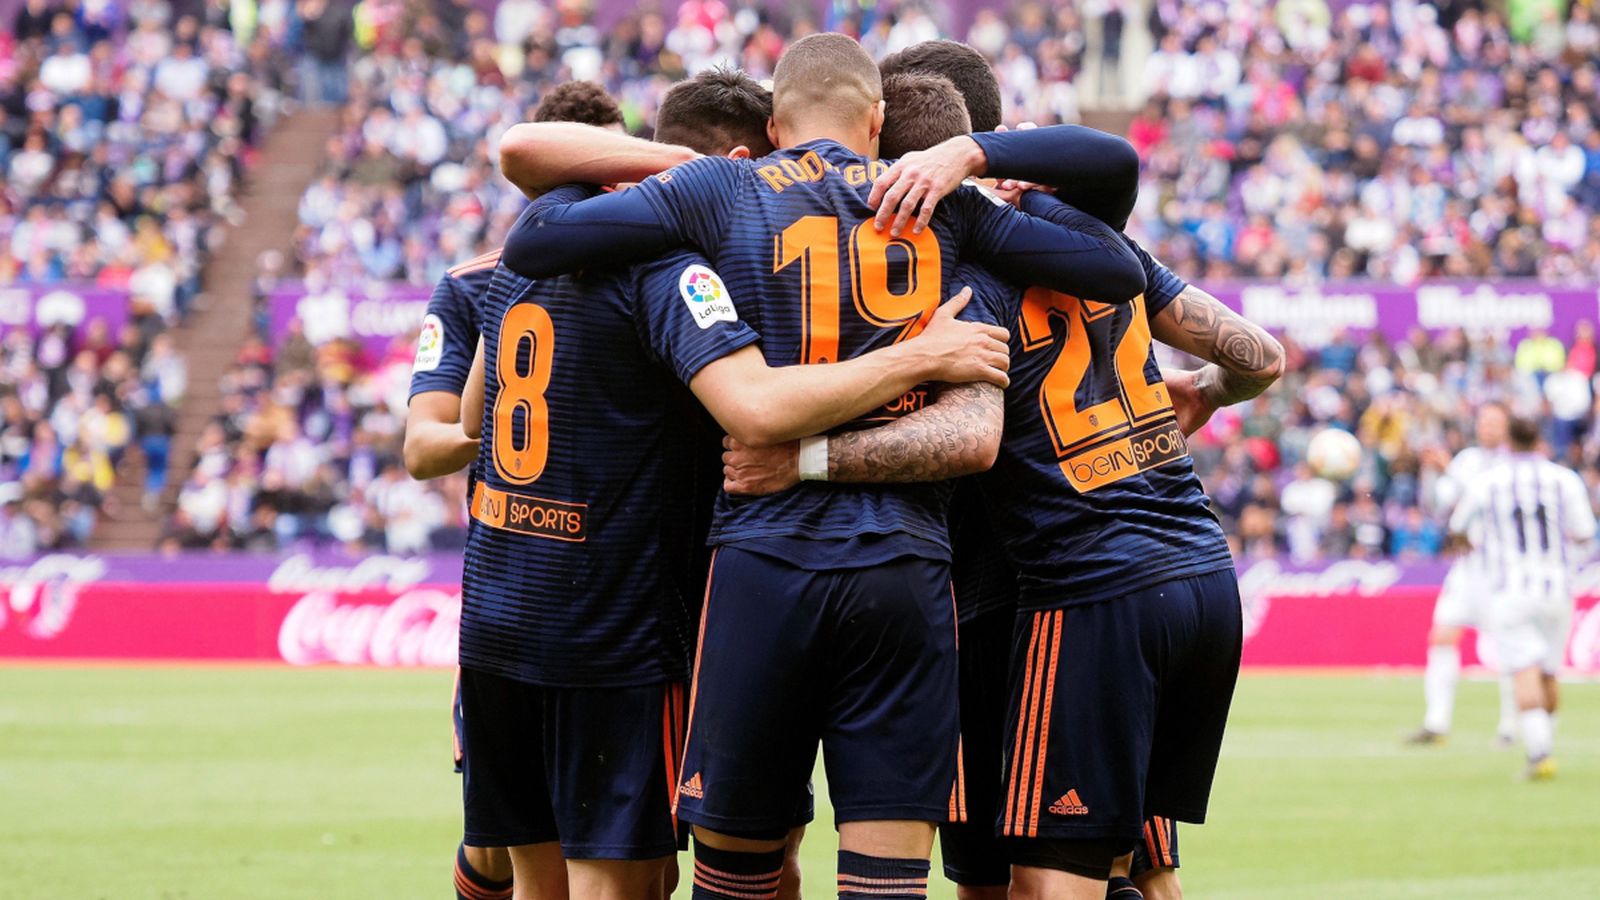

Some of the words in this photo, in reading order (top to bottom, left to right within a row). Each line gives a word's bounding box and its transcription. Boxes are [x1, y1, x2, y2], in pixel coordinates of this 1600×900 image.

[758, 150, 890, 194] RODGO
[773, 215, 942, 365] 19
[698, 303, 731, 319] LaLiga
[1018, 286, 1177, 458] 22
[492, 302, 555, 485] 8
[1133, 429, 1186, 463] SPORT
[510, 502, 581, 533] SPORTS
[1511, 503, 1550, 553] 11
[680, 785, 704, 800] adidas
[1049, 805, 1089, 815] adidas
